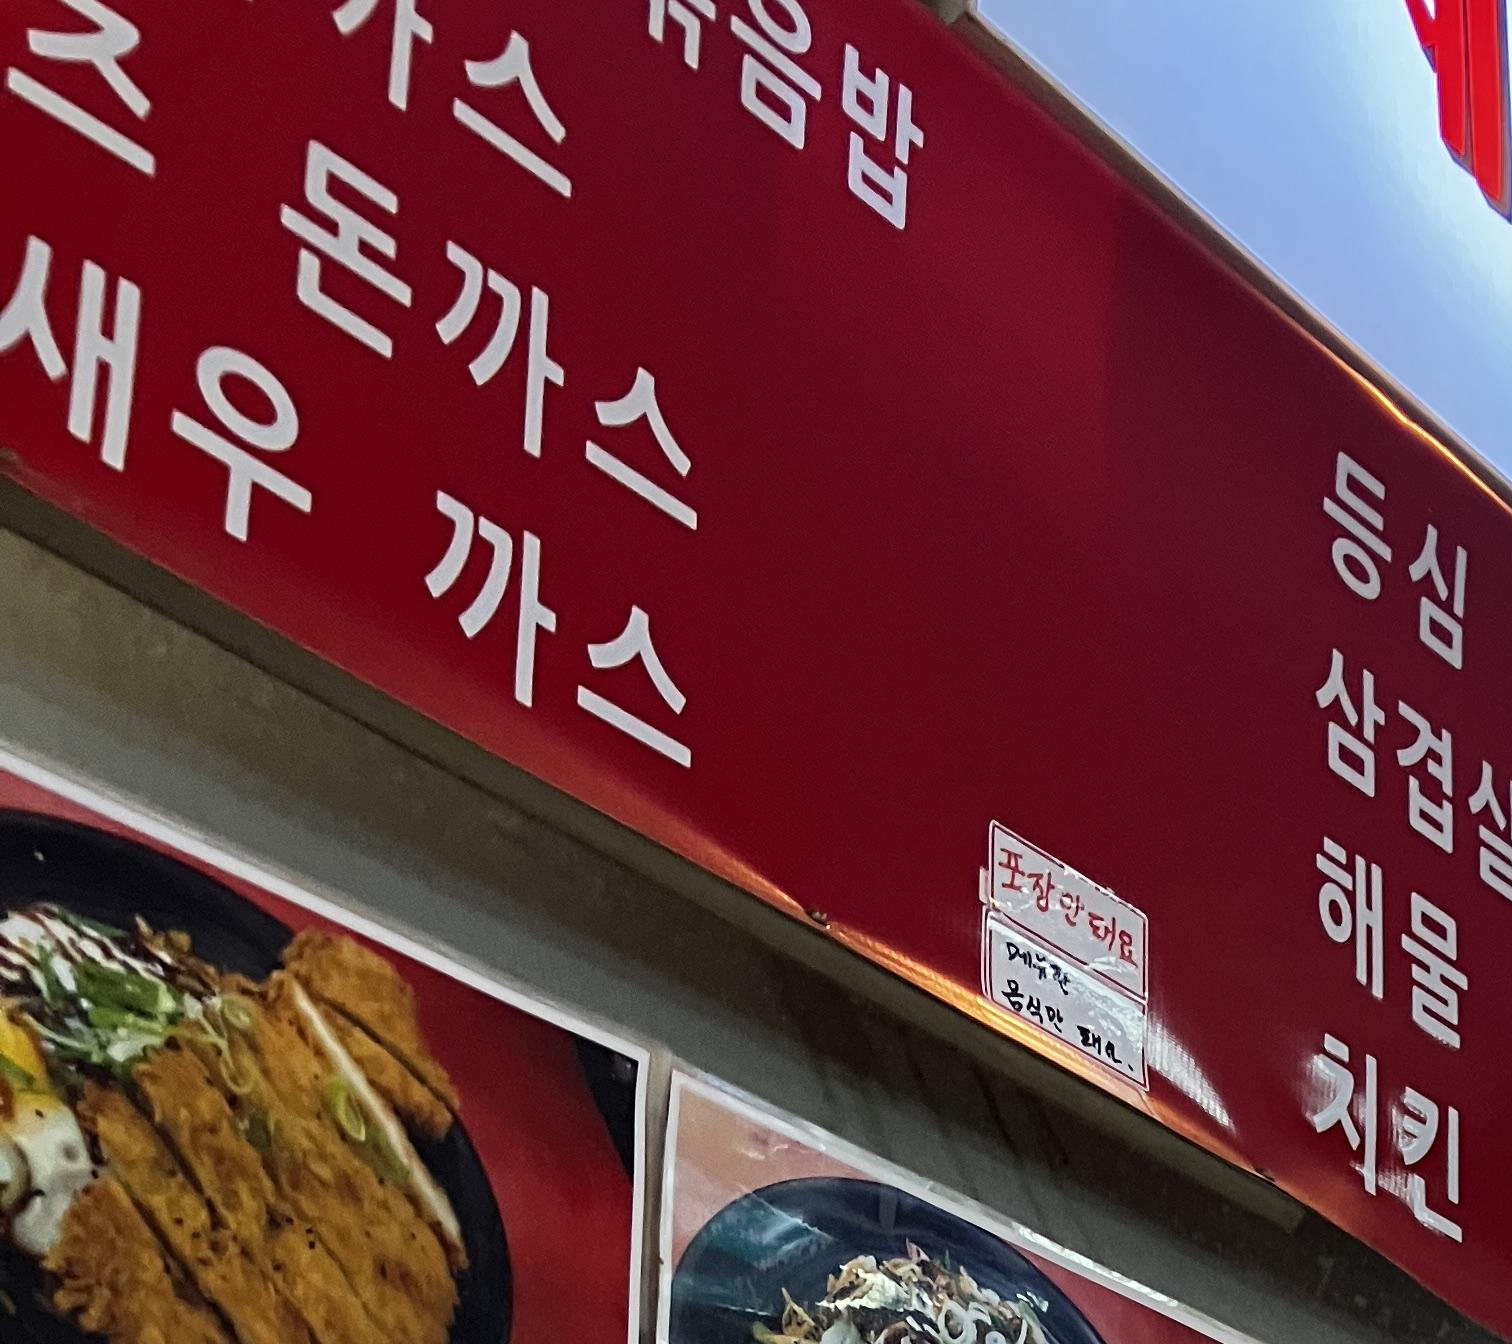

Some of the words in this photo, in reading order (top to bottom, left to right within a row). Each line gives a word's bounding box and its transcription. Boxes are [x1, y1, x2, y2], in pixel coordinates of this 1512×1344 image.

[648, 0, 924, 230] 음밥
[280, 140, 697, 530] 돈까스
[0, 235, 312, 541] 새우
[424, 490, 692, 767] 까스
[1322, 450, 1468, 671] 등심
[1316, 835, 1468, 1049] 해물
[1312, 1033, 1463, 1242] 치킨
